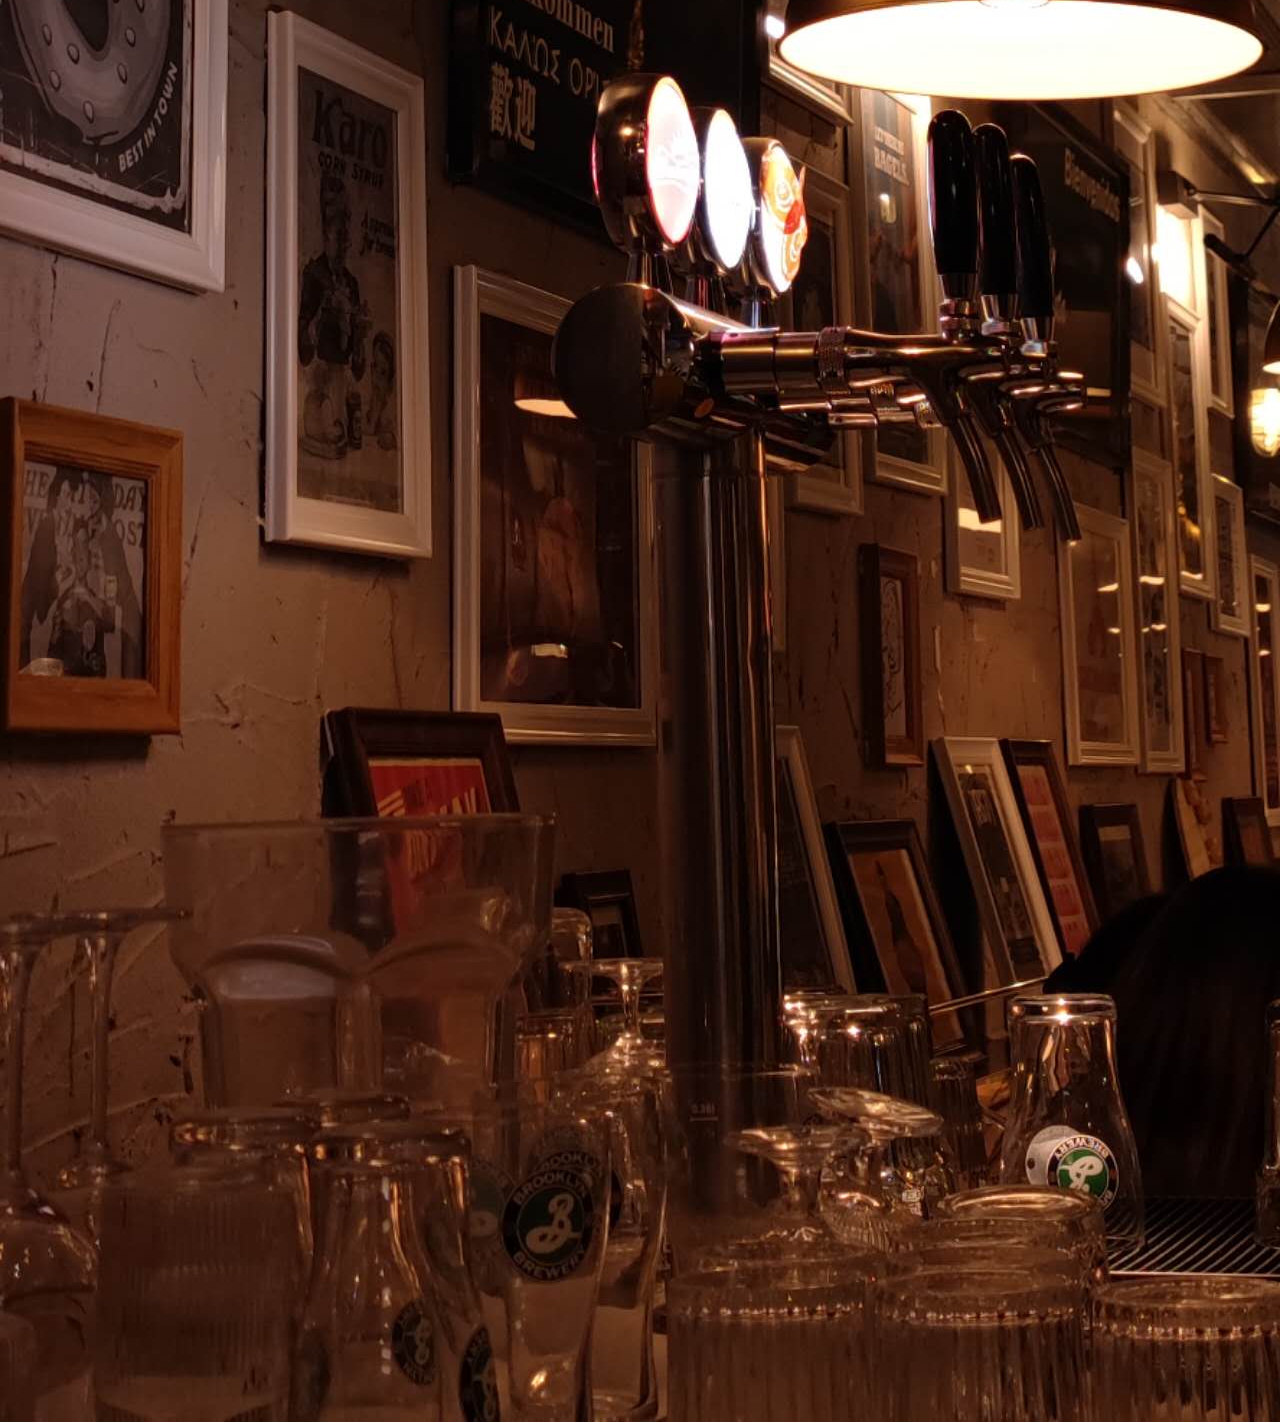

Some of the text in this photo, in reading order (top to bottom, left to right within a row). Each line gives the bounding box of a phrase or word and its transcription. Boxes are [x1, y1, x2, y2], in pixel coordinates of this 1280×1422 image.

[118, 61, 178, 172] BEST IN TOWN
[312, 89, 387, 169] Karo
[318, 152, 345, 175] CORN
[512, 1243, 586, 1280] BREWERY
